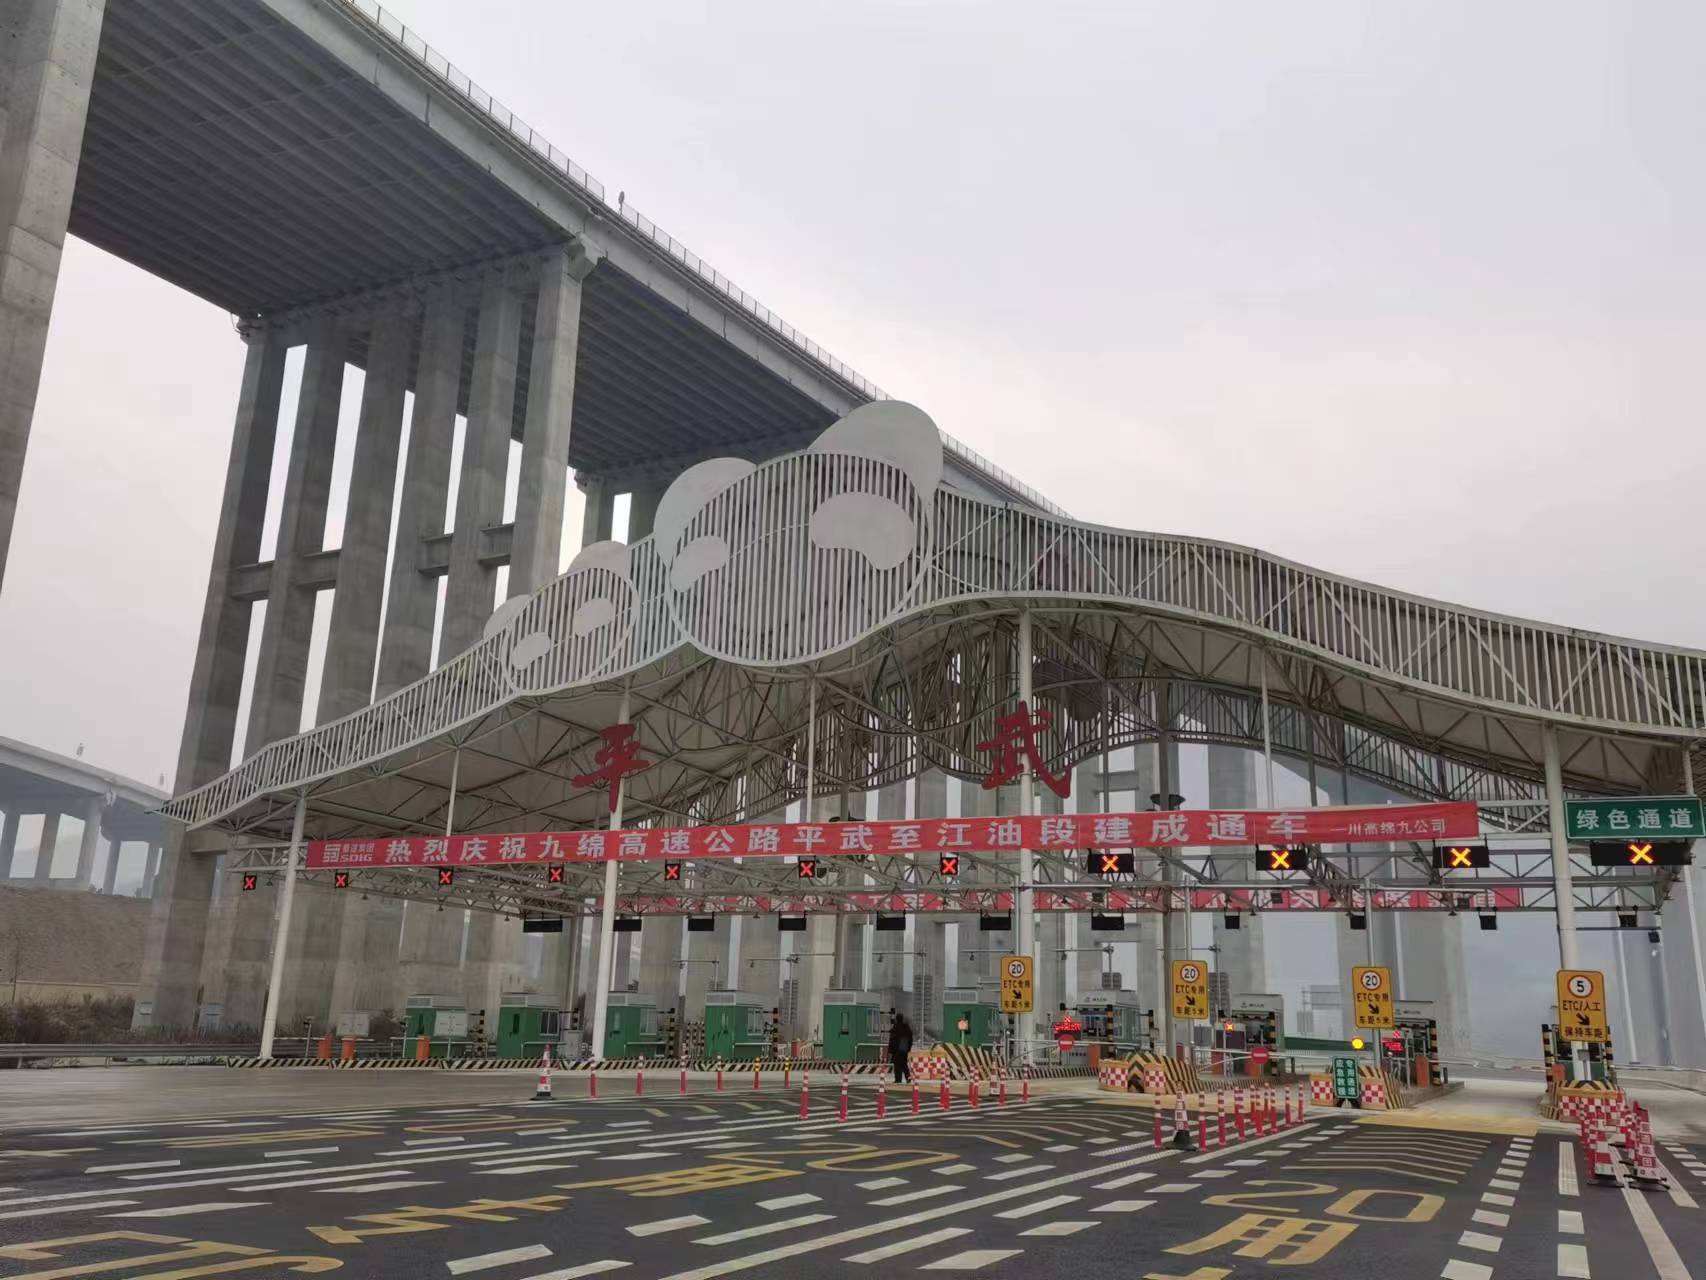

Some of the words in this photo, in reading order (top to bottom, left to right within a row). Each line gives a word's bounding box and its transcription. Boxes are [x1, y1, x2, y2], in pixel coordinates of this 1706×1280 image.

[977, 701, 1072, 798] 武
[1576, 808, 1694, 830] 绿色通道
[386, 812, 1308, 863] 热烈庆祝九绵高速公路平武至江油段建成通车
[1011, 964, 1022, 974] 20
[1184, 968, 1196, 979] 20
[1365, 975, 1378, 986] 20
[1576, 980, 1585, 993] 5
[1562, 1000, 1601, 1011] ETC/人工
